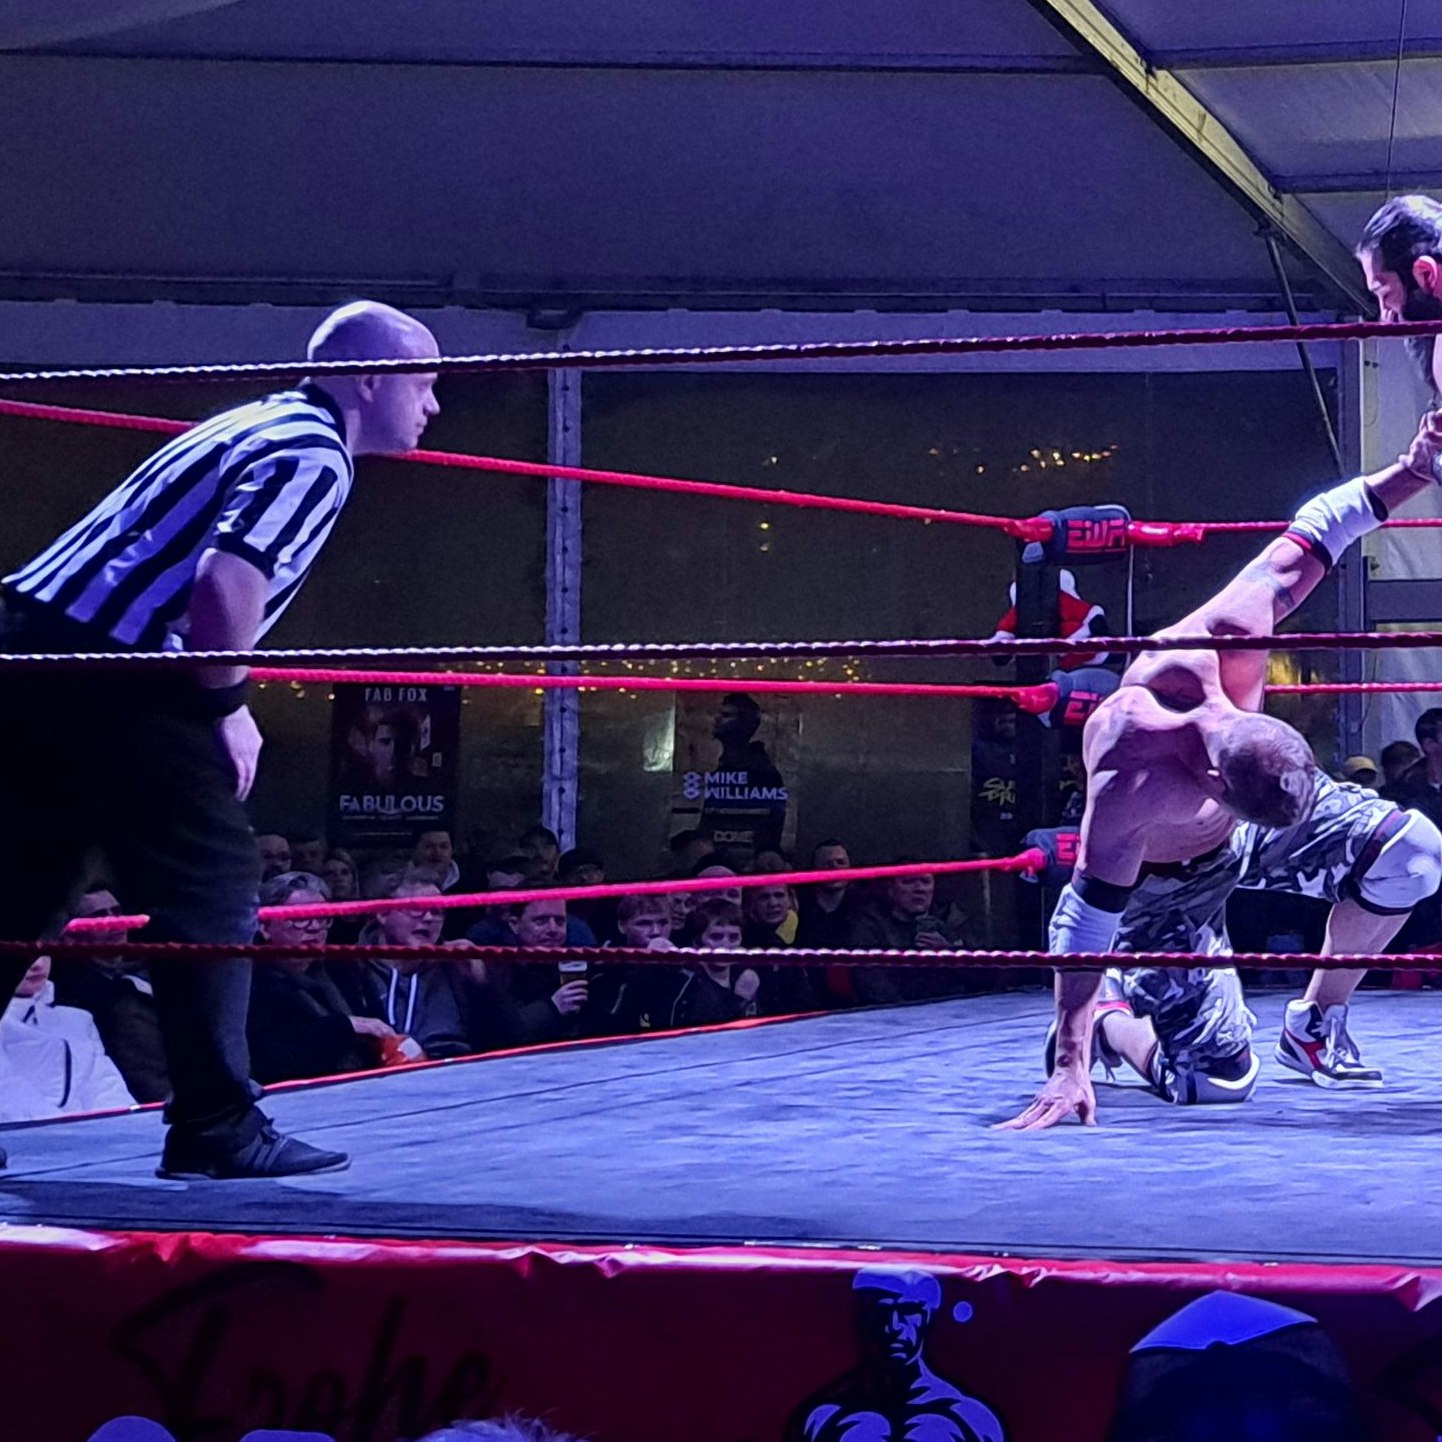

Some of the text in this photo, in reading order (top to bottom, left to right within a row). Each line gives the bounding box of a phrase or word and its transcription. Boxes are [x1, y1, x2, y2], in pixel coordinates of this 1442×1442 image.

[364, 687, 429, 702] FAB FOX
[703, 770, 749, 785] MIKE
[703, 786, 790, 800] WILLIAMS
[339, 794, 446, 815] FABULOUS
